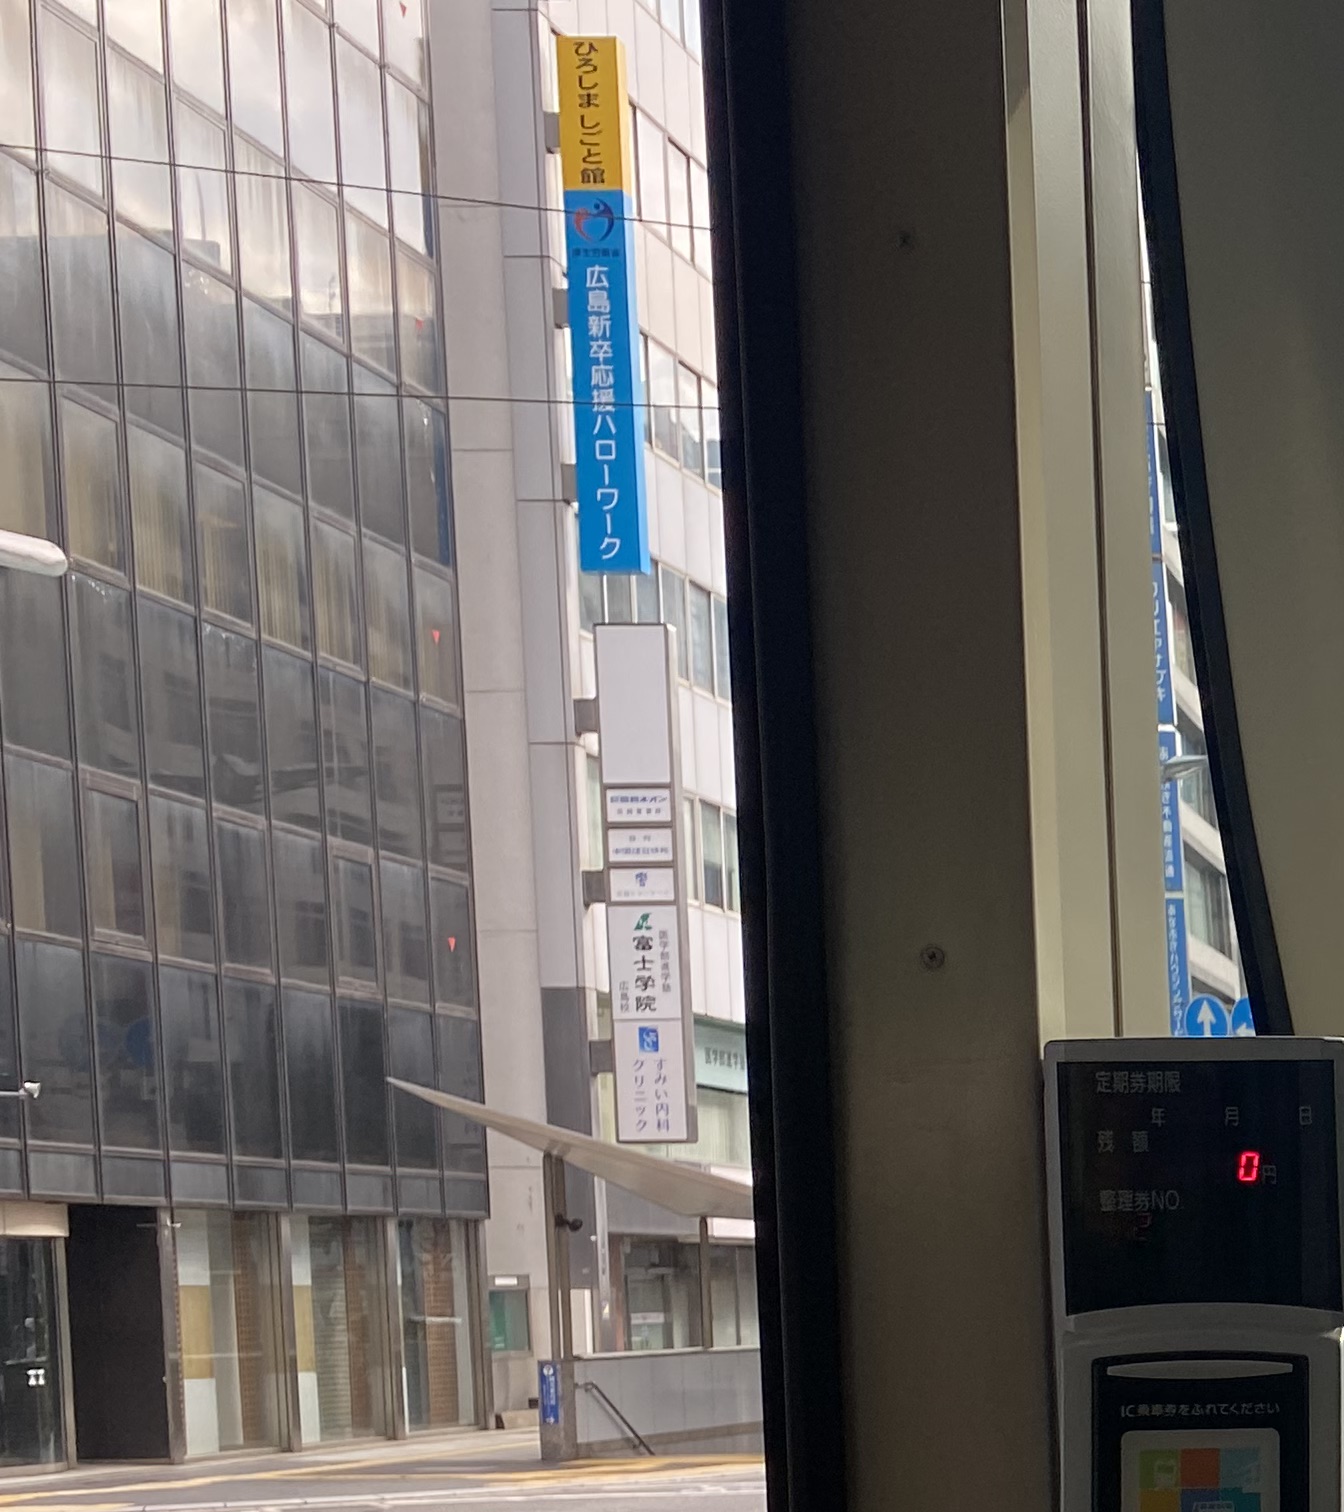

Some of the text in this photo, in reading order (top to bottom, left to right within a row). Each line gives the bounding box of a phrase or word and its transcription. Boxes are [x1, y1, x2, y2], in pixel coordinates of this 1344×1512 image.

[585, 264, 621, 560] 広島新卒応援ハローワーク
[632, 934, 657, 1013] 富士学院
[633, 1059, 648, 1133] クリニック
[1096, 1071, 1181, 1094] 定期券期限
[1151, 1107, 1167, 1127] 年
[1224, 1106, 1240, 1127] 月
